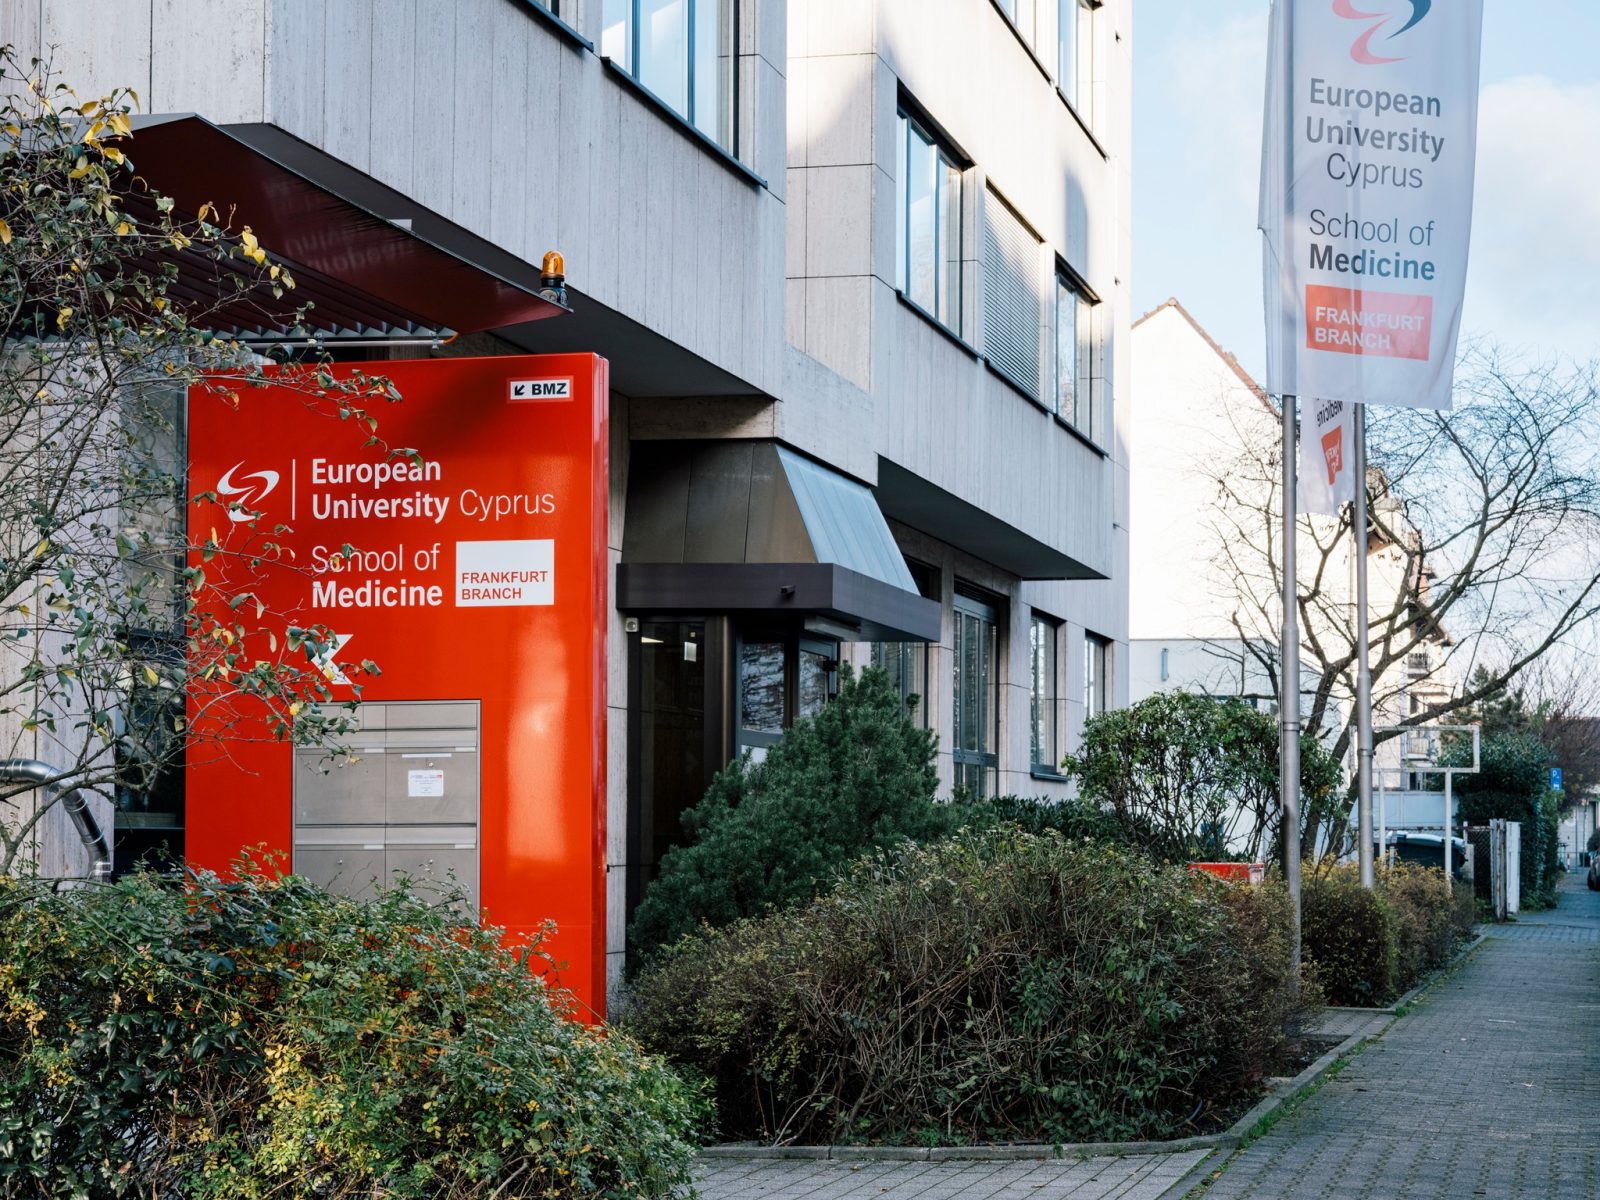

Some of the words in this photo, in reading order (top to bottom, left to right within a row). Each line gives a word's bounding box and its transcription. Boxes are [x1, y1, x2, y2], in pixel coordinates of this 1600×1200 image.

[1310, 77, 1441, 117] European
[1306, 115, 1445, 162] University
[1327, 152, 1423, 189] Cyprus
[1309, 208, 1398, 244] School
[1409, 220, 1435, 246] of
[1309, 243, 1435, 281] Medicine
[1315, 305, 1425, 332] FRANKFURT
[1315, 327, 1391, 349] BRANCH
[531, 383, 567, 396] BMZ
[312, 458, 441, 490] European
[312, 491, 450, 525] University
[459, 488, 556, 522] Cyprus
[311, 543, 403, 573] School
[414, 542, 441, 571] of
[461, 570, 549, 584] FRANKFURT
[312, 578, 443, 608] Medicine
[461, 587, 522, 601] BRANCH
